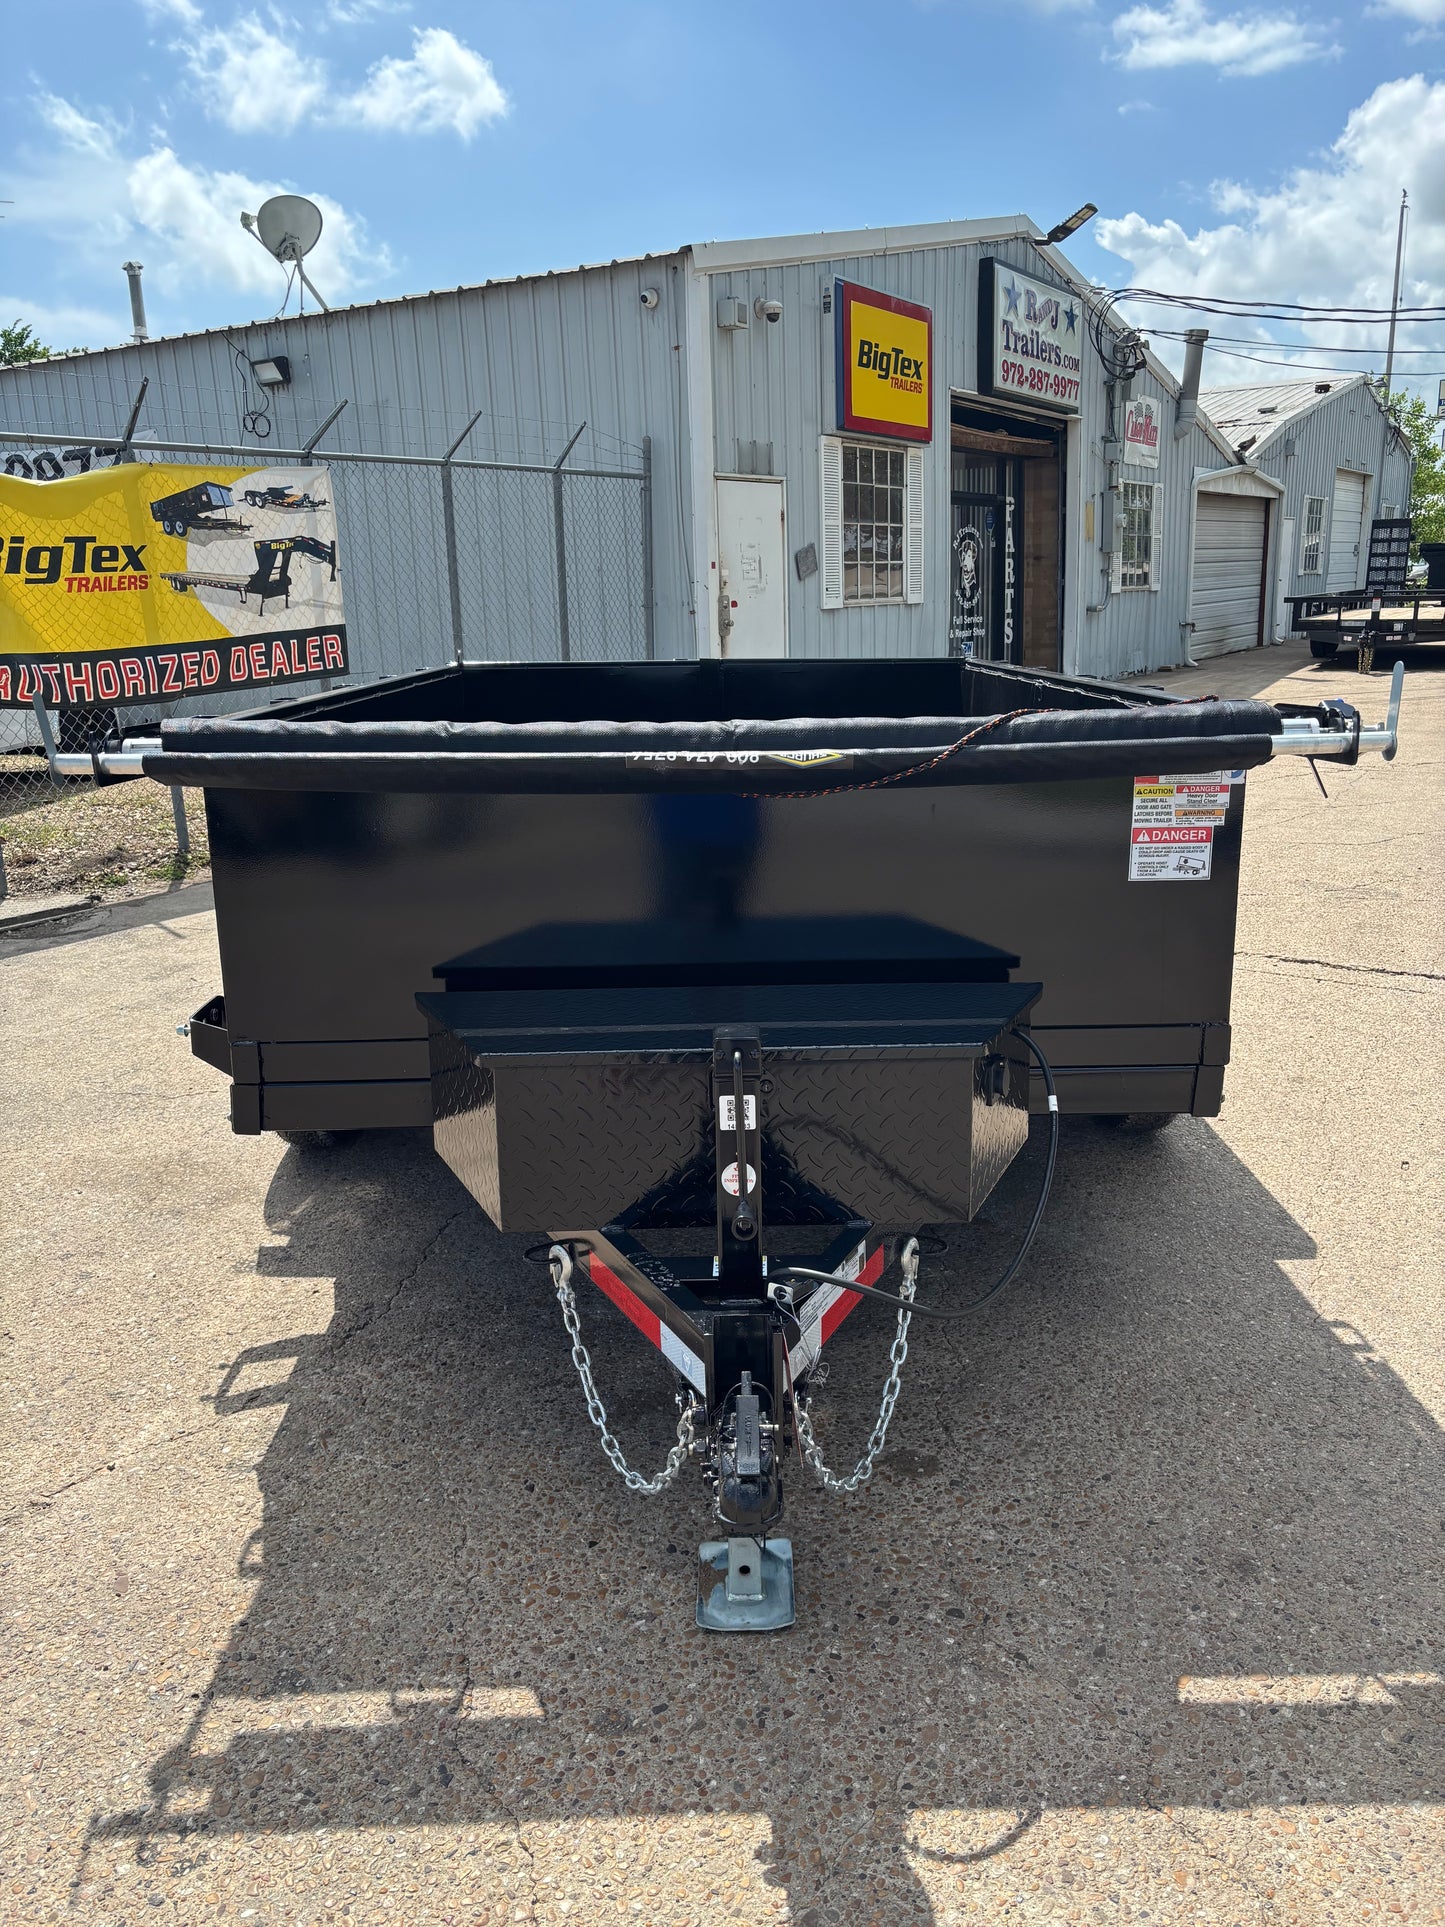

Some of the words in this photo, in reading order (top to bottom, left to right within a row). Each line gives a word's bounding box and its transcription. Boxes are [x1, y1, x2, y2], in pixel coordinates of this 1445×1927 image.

[1024, 289, 1038, 321] R
[858, 340, 923, 380] BigTex
[890, 376, 923, 394] TRAILERS
[1002, 358, 1080, 400] 972-287-9977
[0, 536, 147, 584] igTex
[1005, 497, 1015, 644] PARTS
[64, 574, 149, 593] TRAILERS
[953, 616, 963, 625] Full
[964, 615, 983, 624] Service
[949, 630, 954, 639] &
[955, 629, 972, 640] Repair
[973, 628, 985, 637] Shop
[0, 649, 220, 703] AUTHORIZED
[230, 634, 344, 679] DEALER
[1190, 785, 1220, 793] DANGER
[1152, 830, 1207, 841] DANGER
